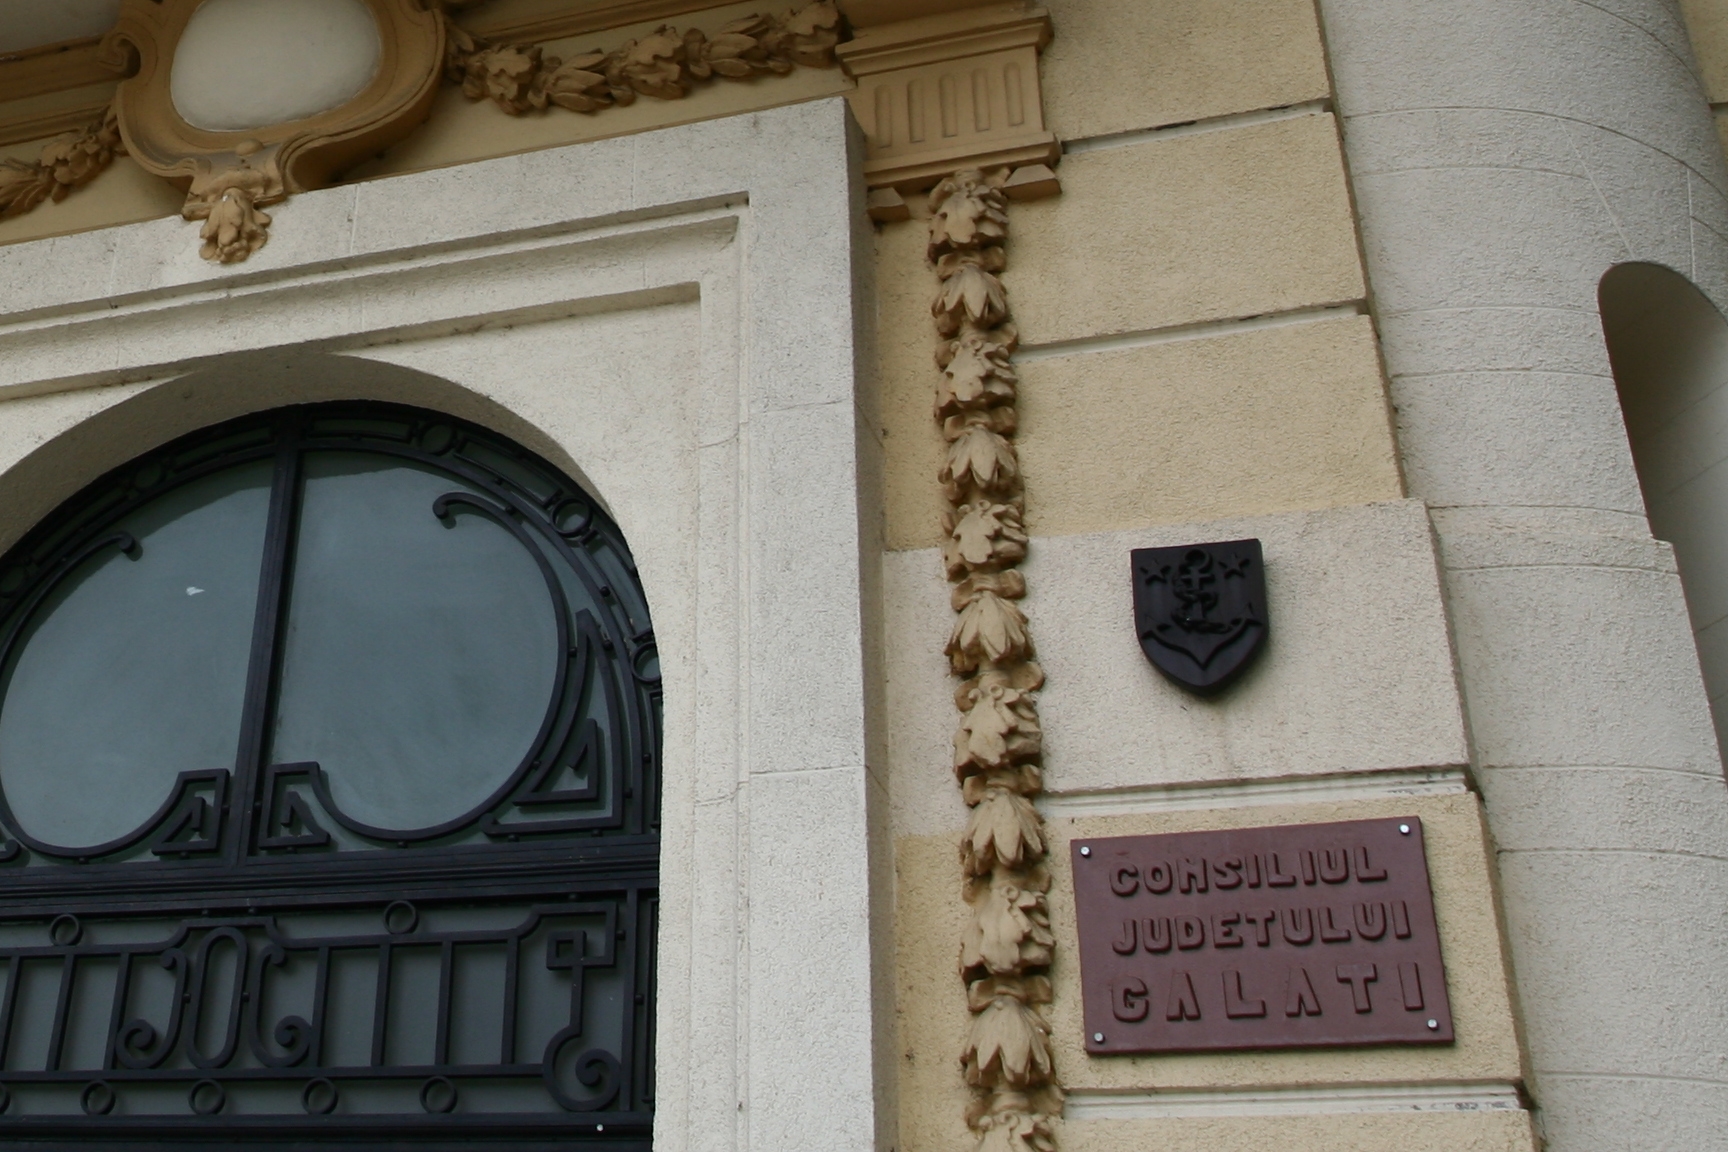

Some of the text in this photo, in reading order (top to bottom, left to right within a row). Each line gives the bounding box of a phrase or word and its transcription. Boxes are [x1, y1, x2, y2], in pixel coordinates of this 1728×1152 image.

[1109, 846, 1388, 897] CONSILIUL
[1111, 900, 1412, 955] JUDETULUI
[1110, 960, 1425, 1023] GALATI
